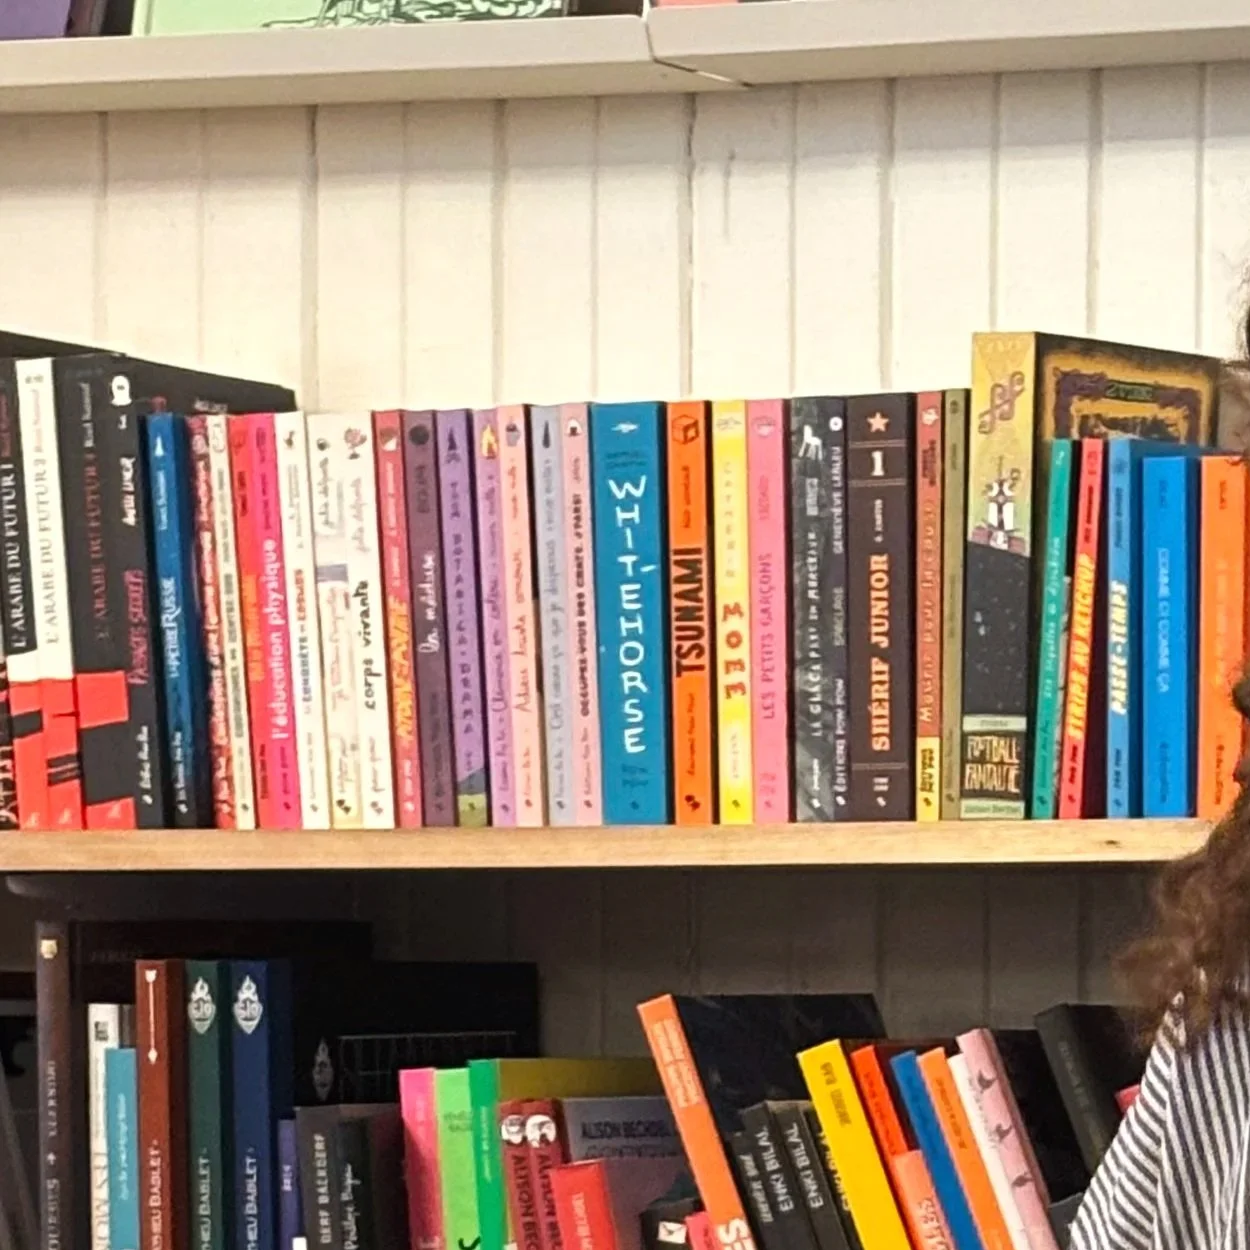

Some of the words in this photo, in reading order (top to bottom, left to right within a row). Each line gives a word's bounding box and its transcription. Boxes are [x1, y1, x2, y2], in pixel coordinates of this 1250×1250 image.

[1, 476, 19, 536] FUTUR
[33, 470, 52, 533] FUTUR
[84, 466, 101, 529] FUTUR
[830, 490, 846, 555] GENEVIÈVE
[3, 542, 21, 568] DU
[36, 538, 53, 564] DU
[88, 533, 104, 559] DU
[262, 539, 287, 626] physique
[672, 546, 708, 679] TSUNAMI
[756, 551, 776, 627] GARÇONS
[868, 552, 890, 649] JUNIOR
[1072, 552, 1097, 637] KETCHUP
[759, 632, 775, 683] PETITS
[1073, 639, 1091, 668] AU
[1107, 580, 1129, 716] PASSE-TEMPS
[267, 632, 290, 740] l'éducation
[362, 657, 383, 711] corps
[760, 691, 776, 720] LES
[867, 656, 891, 751] SHÉRIF
[833, 738, 847, 793] ÉDITIONS
[314, 1133, 330, 1205] BACKDERF
[754, 1125, 781, 1172] BILAL
[783, 1122, 811, 1169] BILAL
[148, 1147, 164, 1208] BABLET
[198, 1156, 213, 1216] BABLET
[245, 1156, 259, 1216] BABLET
[511, 1154, 532, 1216] ALISON
[768, 1172, 794, 1213] ENKI
[799, 1169, 825, 1209] ENKI
[319, 1210, 332, 1244] DERF
